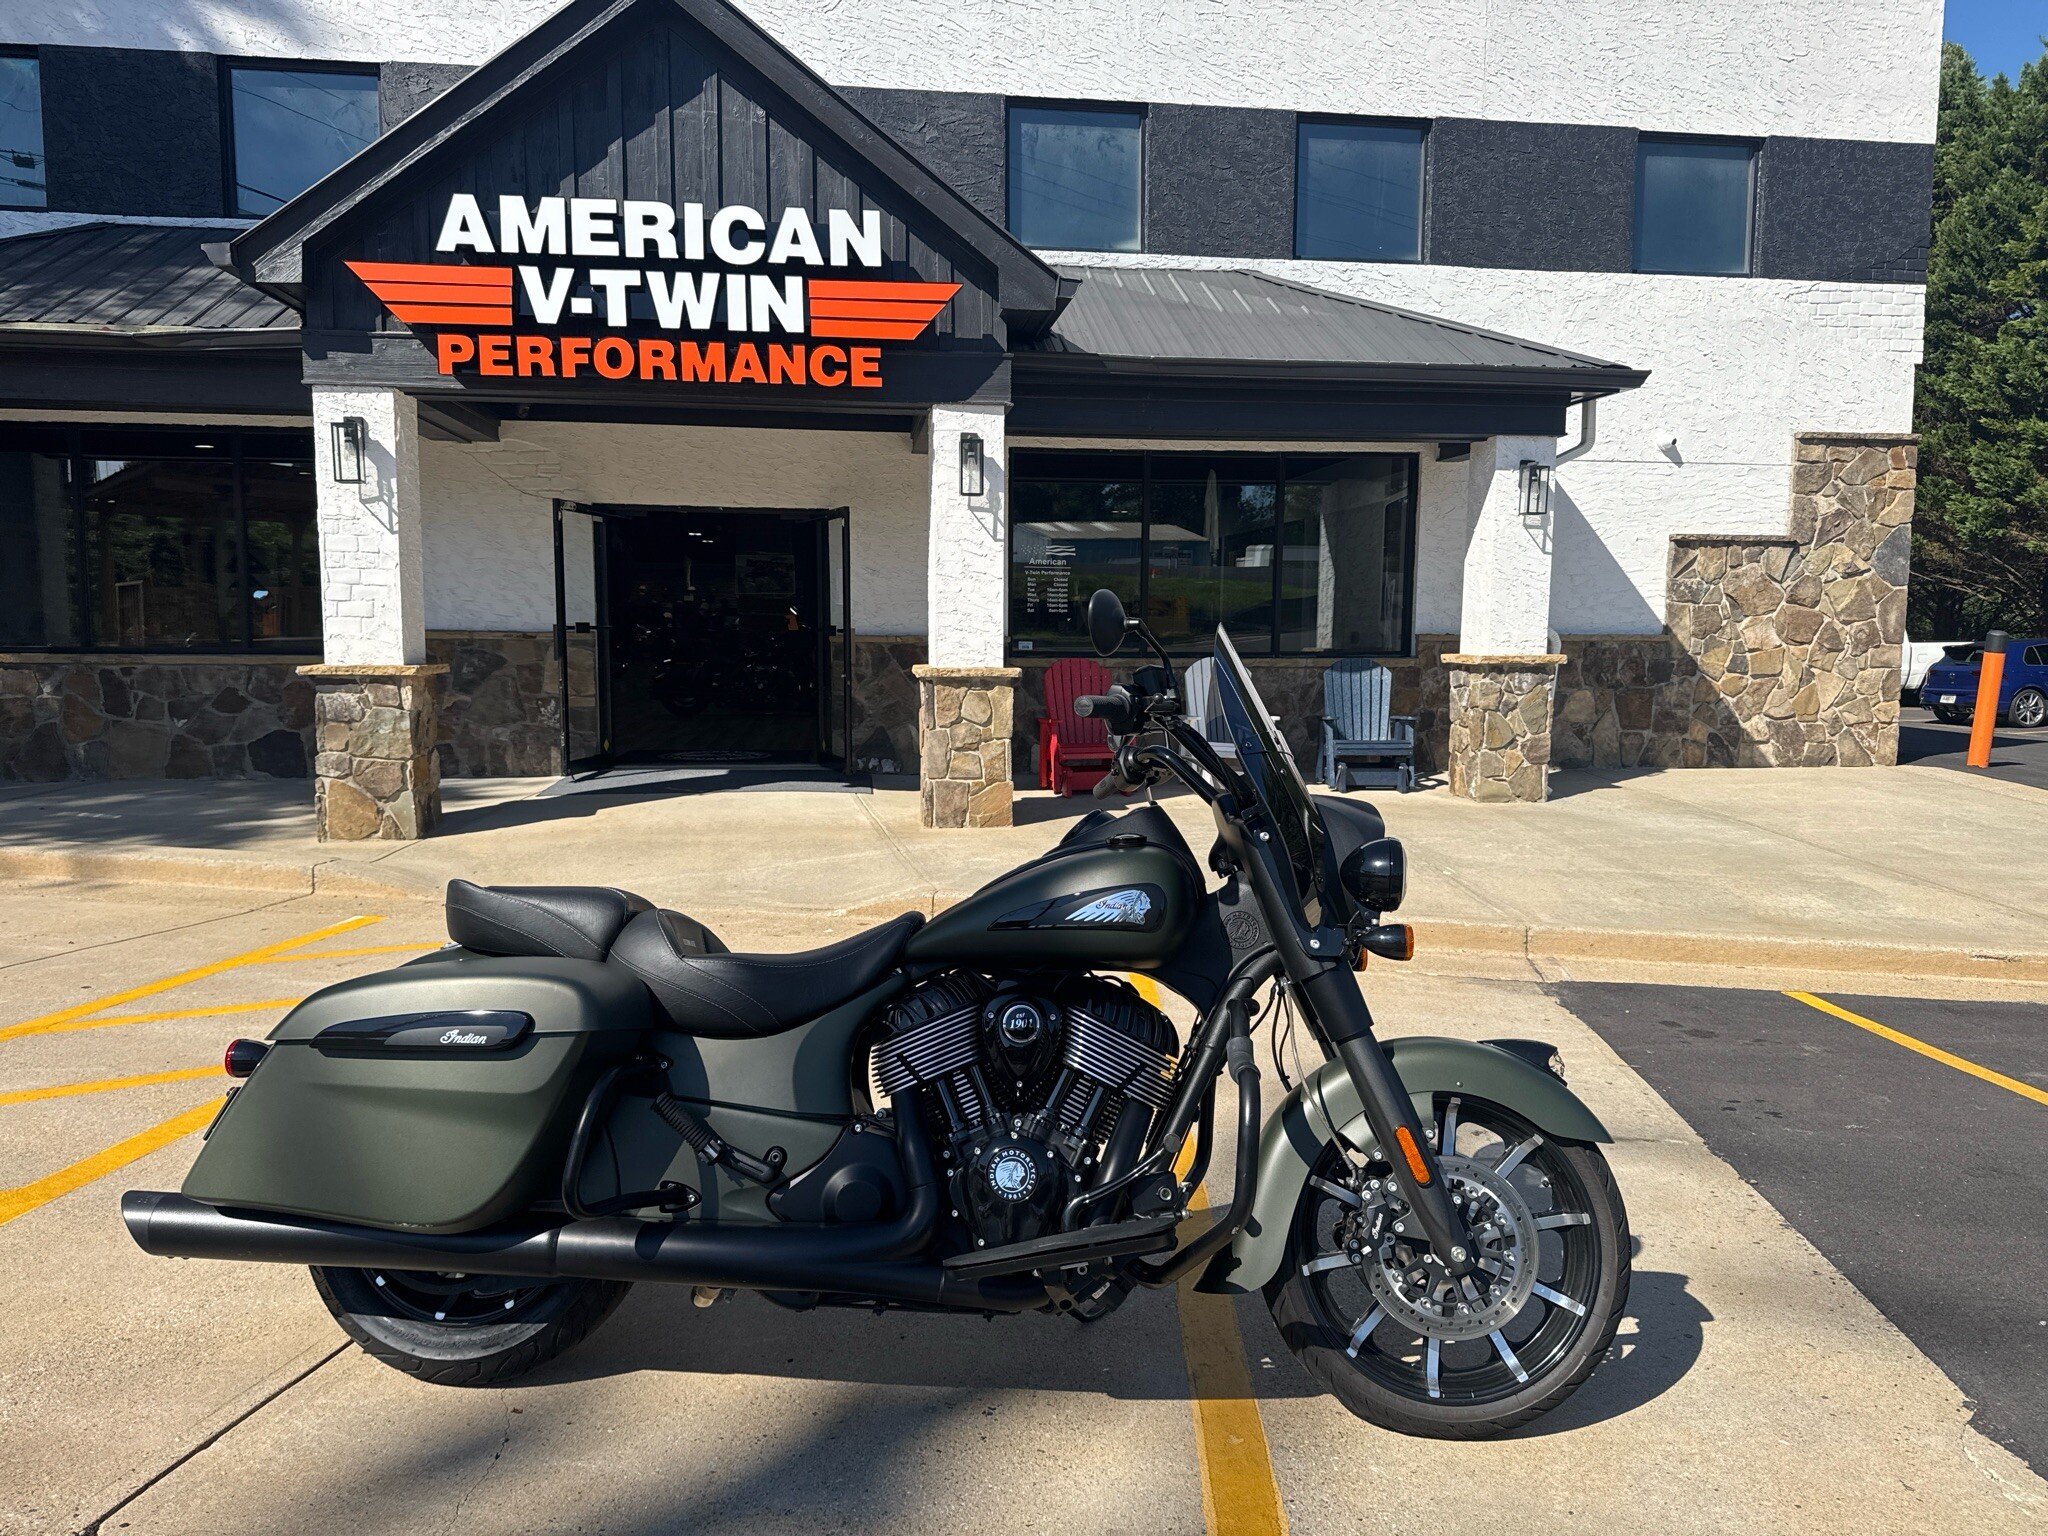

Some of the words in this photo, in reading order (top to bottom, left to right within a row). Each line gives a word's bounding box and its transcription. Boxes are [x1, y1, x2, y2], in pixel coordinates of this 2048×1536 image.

[436, 193, 882, 267] AMERICAN
[518, 266, 805, 333] V-TWIN
[437, 333, 883, 388] PERFORMANCE
[1029, 557, 1067, 566] American
[1095, 899, 1129, 911] Indian
[439, 1029, 487, 1044] Indian
[1010, 1018, 1033, 1029] 1901
[990, 1156, 1001, 1190] INDIAN
[1001, 1150, 1036, 1190] MOTORCYCLE
